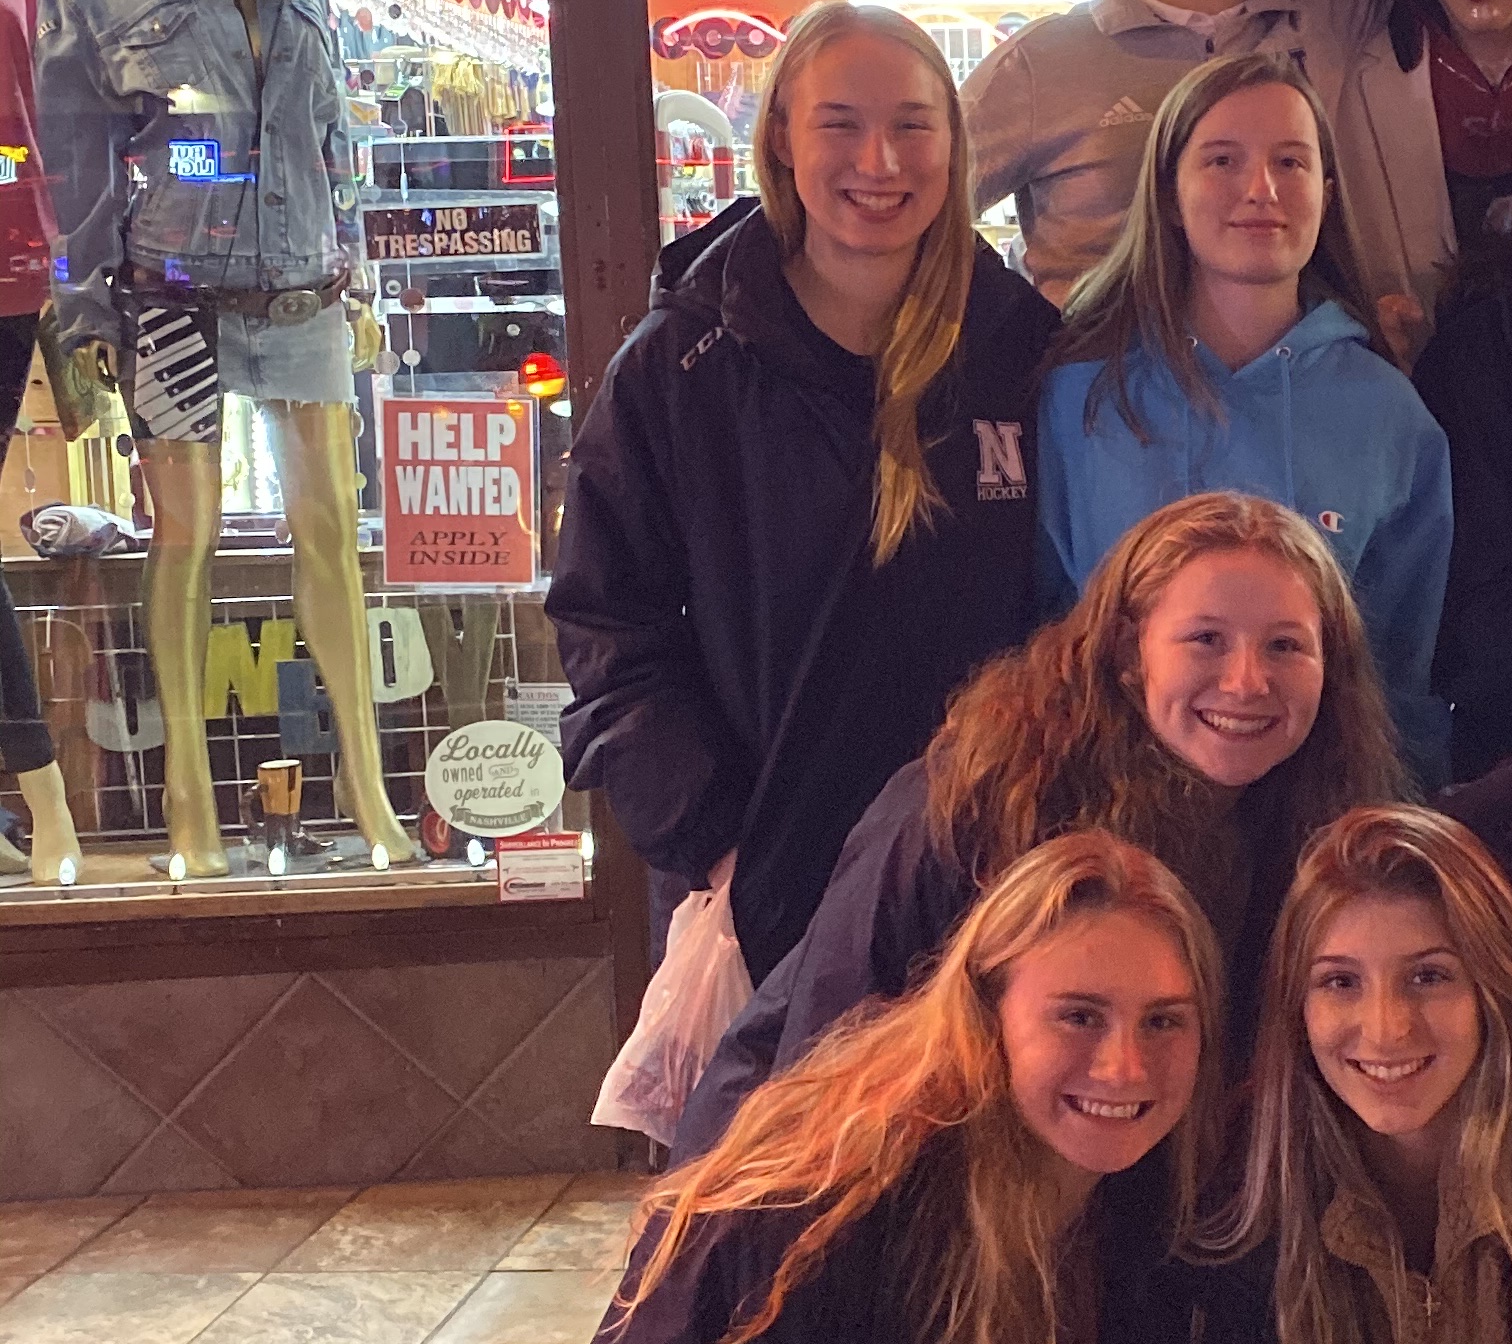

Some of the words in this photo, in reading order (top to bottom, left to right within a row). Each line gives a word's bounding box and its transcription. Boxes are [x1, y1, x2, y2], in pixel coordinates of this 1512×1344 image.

[435, 207, 468, 231] NO
[374, 228, 532, 259] TRESPASSING
[397, 412, 517, 461] HELP
[973, 419, 1027, 486] N
[395, 465, 520, 516] WANTED
[977, 487, 1027, 501] HOCKEY
[410, 530, 509, 547] APPLY
[408, 550, 511, 566] INSIDE
[440, 730, 545, 769] Locally
[442, 763, 483, 783] owned
[454, 779, 526, 806] operated
[469, 812, 528, 825] NASHVILLE
